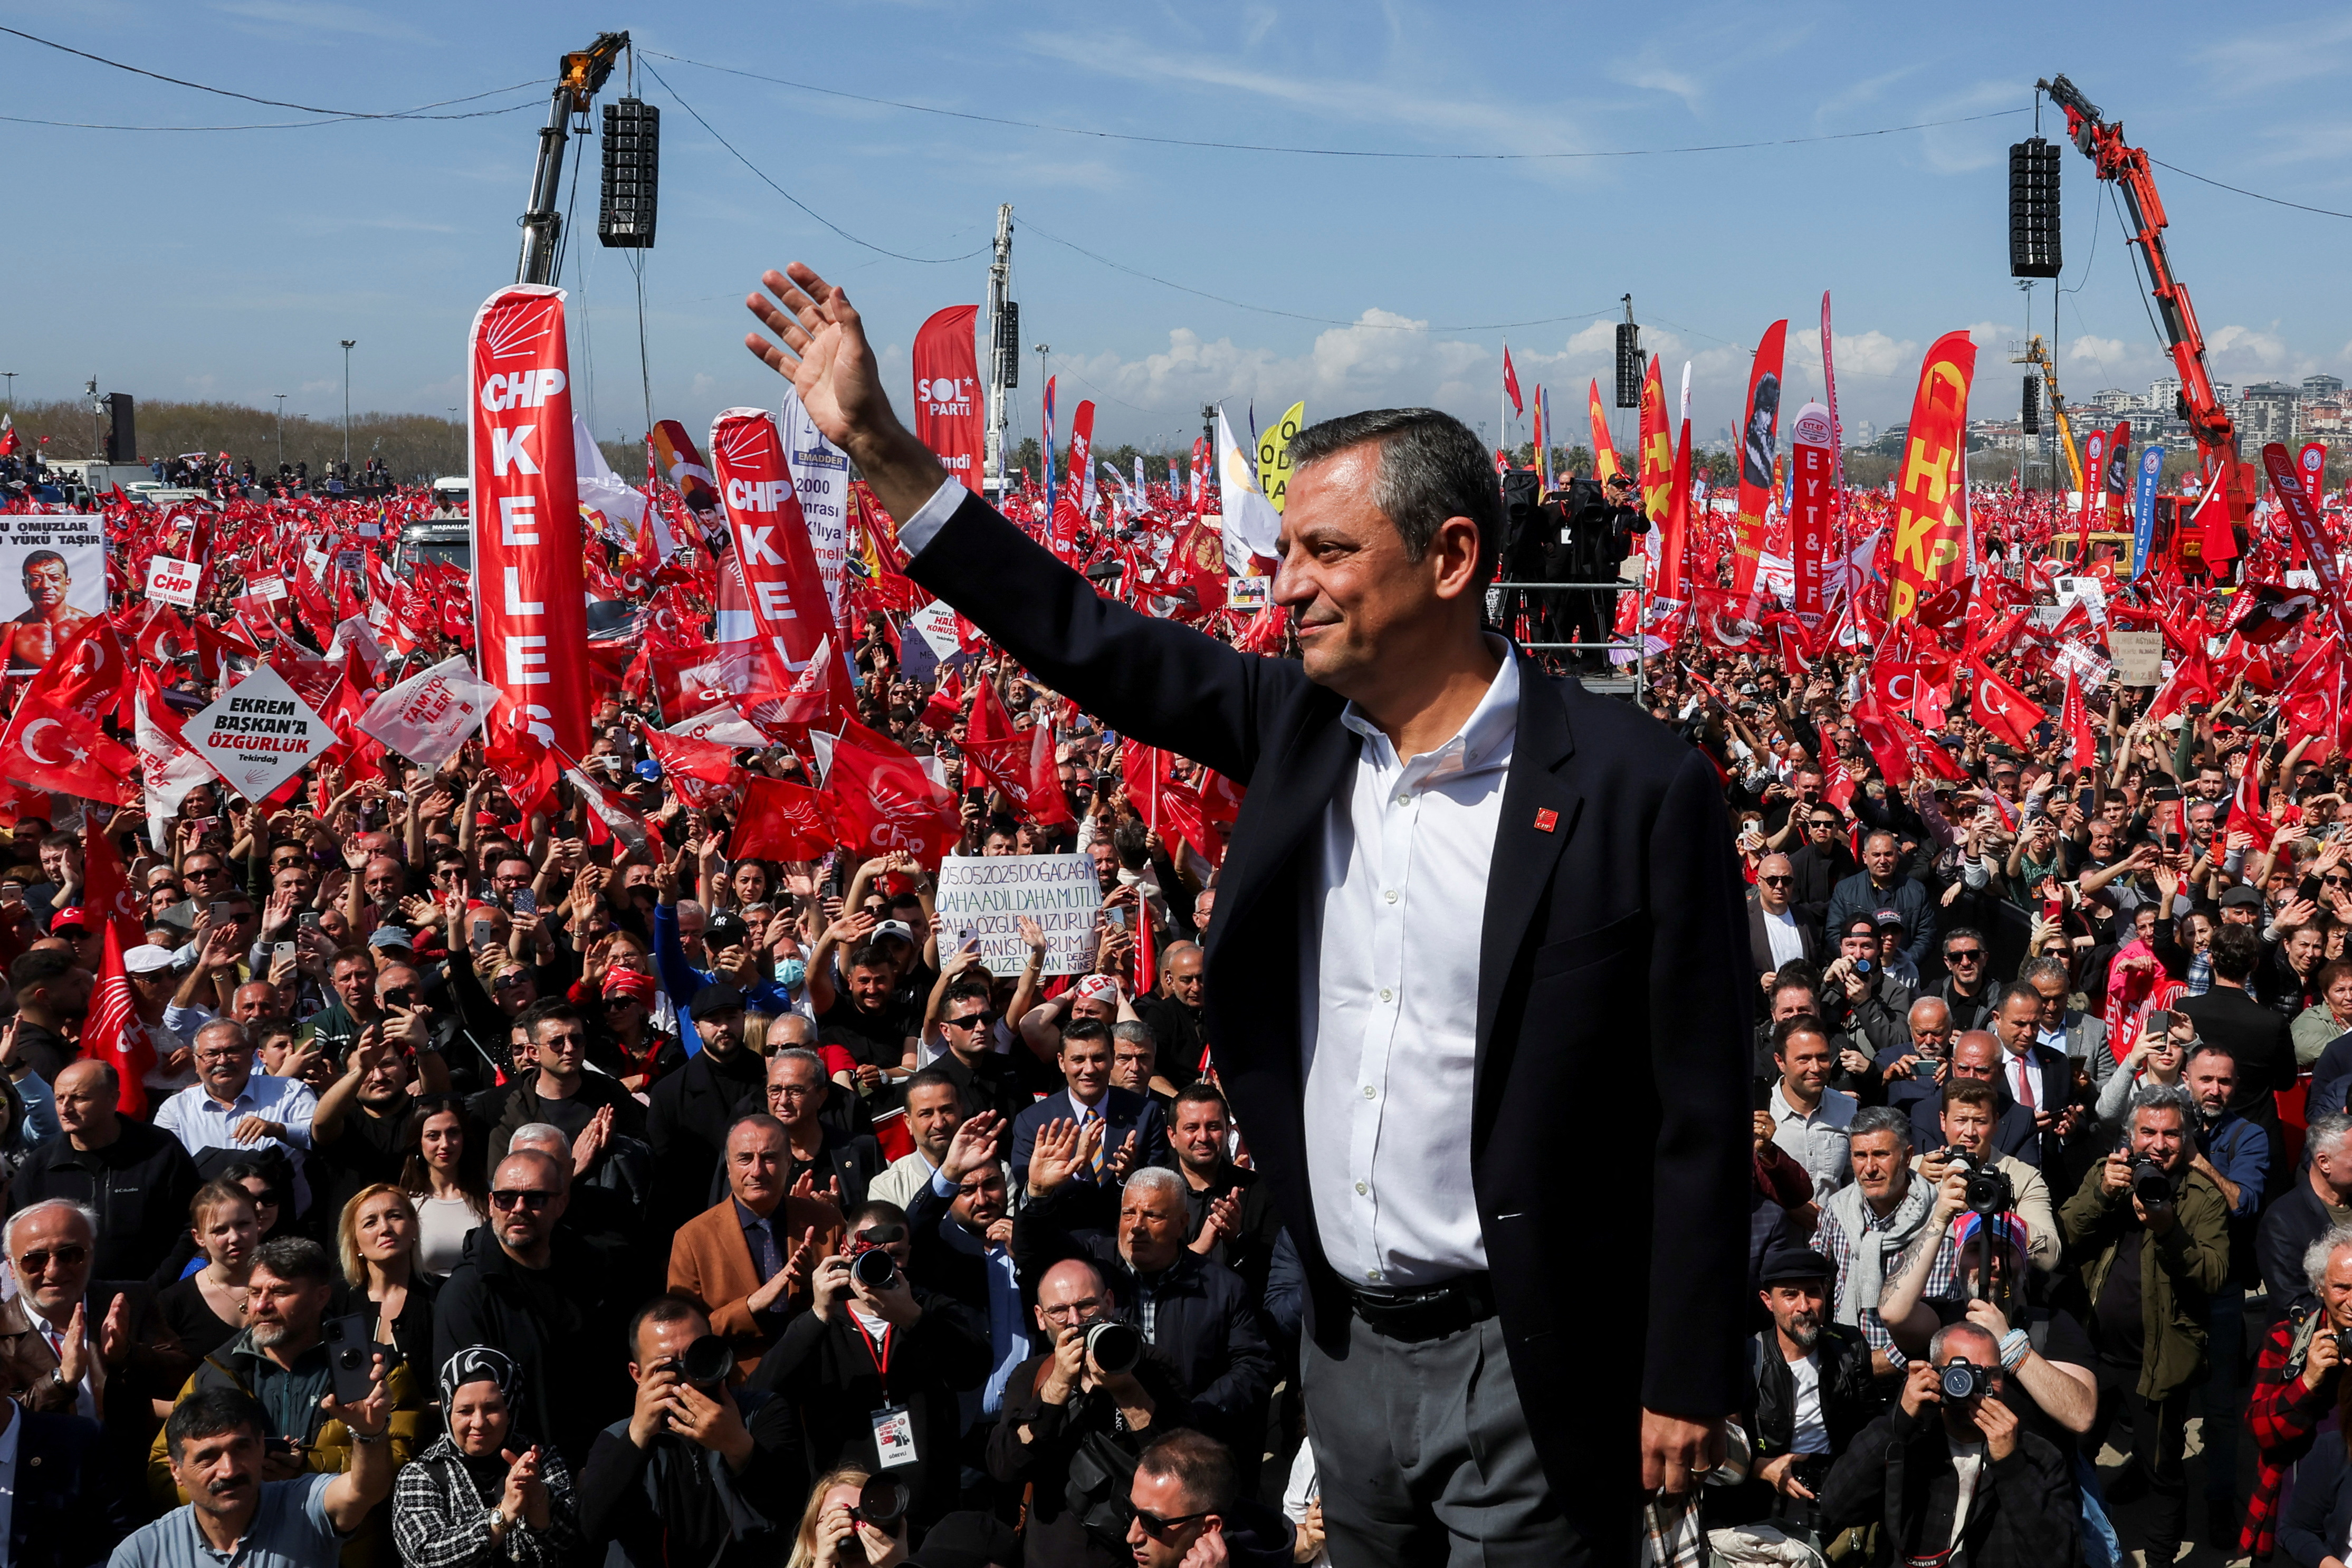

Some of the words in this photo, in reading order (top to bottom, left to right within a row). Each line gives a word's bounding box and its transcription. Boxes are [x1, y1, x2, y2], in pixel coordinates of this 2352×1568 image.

[481, 368, 566, 412] CHP
[1803, 422, 1824, 432] EYT-EF
[798, 453, 843, 465] EMADDER
[796, 478, 830, 495] 2000
[2280, 476, 2296, 487] CHP
[726, 478, 792, 512] CHP
[799, 504, 839, 518] onrası
[2137, 478, 2152, 556] BELEDİYE
[17, 522, 89, 532] OMUZLAR
[10, 532, 51, 544] YÜKÜ
[58, 535, 100, 547] TAŞIR
[153, 573, 193, 592] CHP
[934, 616, 954, 626] HAL
[229, 697, 295, 715] EKREM
[403, 693, 432, 723] TAM
[425, 674, 447, 694] YOL
[421, 687, 455, 724] İLERİ
[214, 715, 308, 735] BAŞKAN'A
[238, 754, 278, 765] Tekirdağ
[1001, 780, 1029, 805] CHP
[871, 823, 925, 854] CHP
[937, 891, 983, 912] DAHA
[1017, 888, 1057, 910] DAHA
[1057, 886, 1103, 909] MUTLU
[714, 916, 727, 926] NY
[1906, 1557, 1937, 1567] Canon
